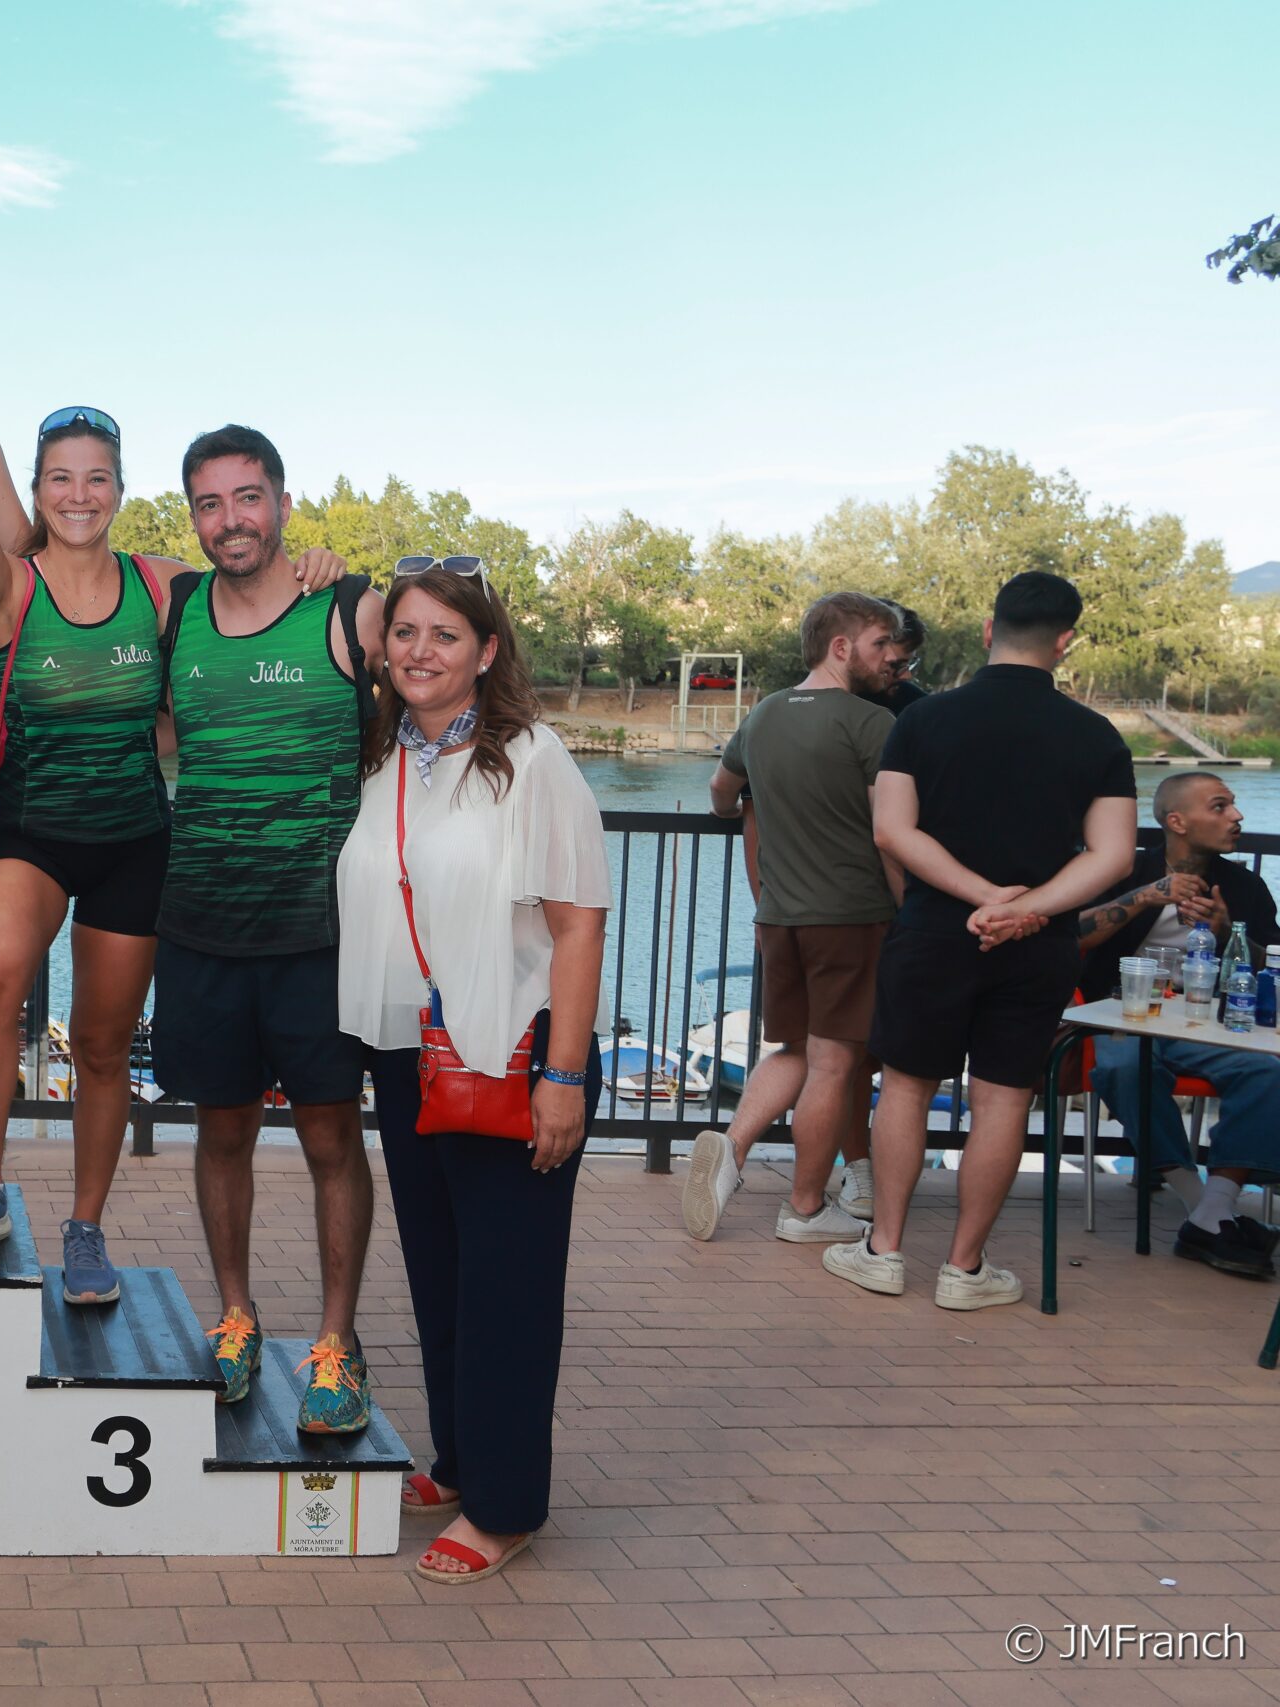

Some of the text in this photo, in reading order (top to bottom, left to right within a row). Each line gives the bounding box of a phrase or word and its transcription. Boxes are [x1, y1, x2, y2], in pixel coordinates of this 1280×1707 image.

[110, 643, 153, 665] Júlia
[249, 660, 304, 683] Júlia
[87, 1416, 151, 1507] 3
